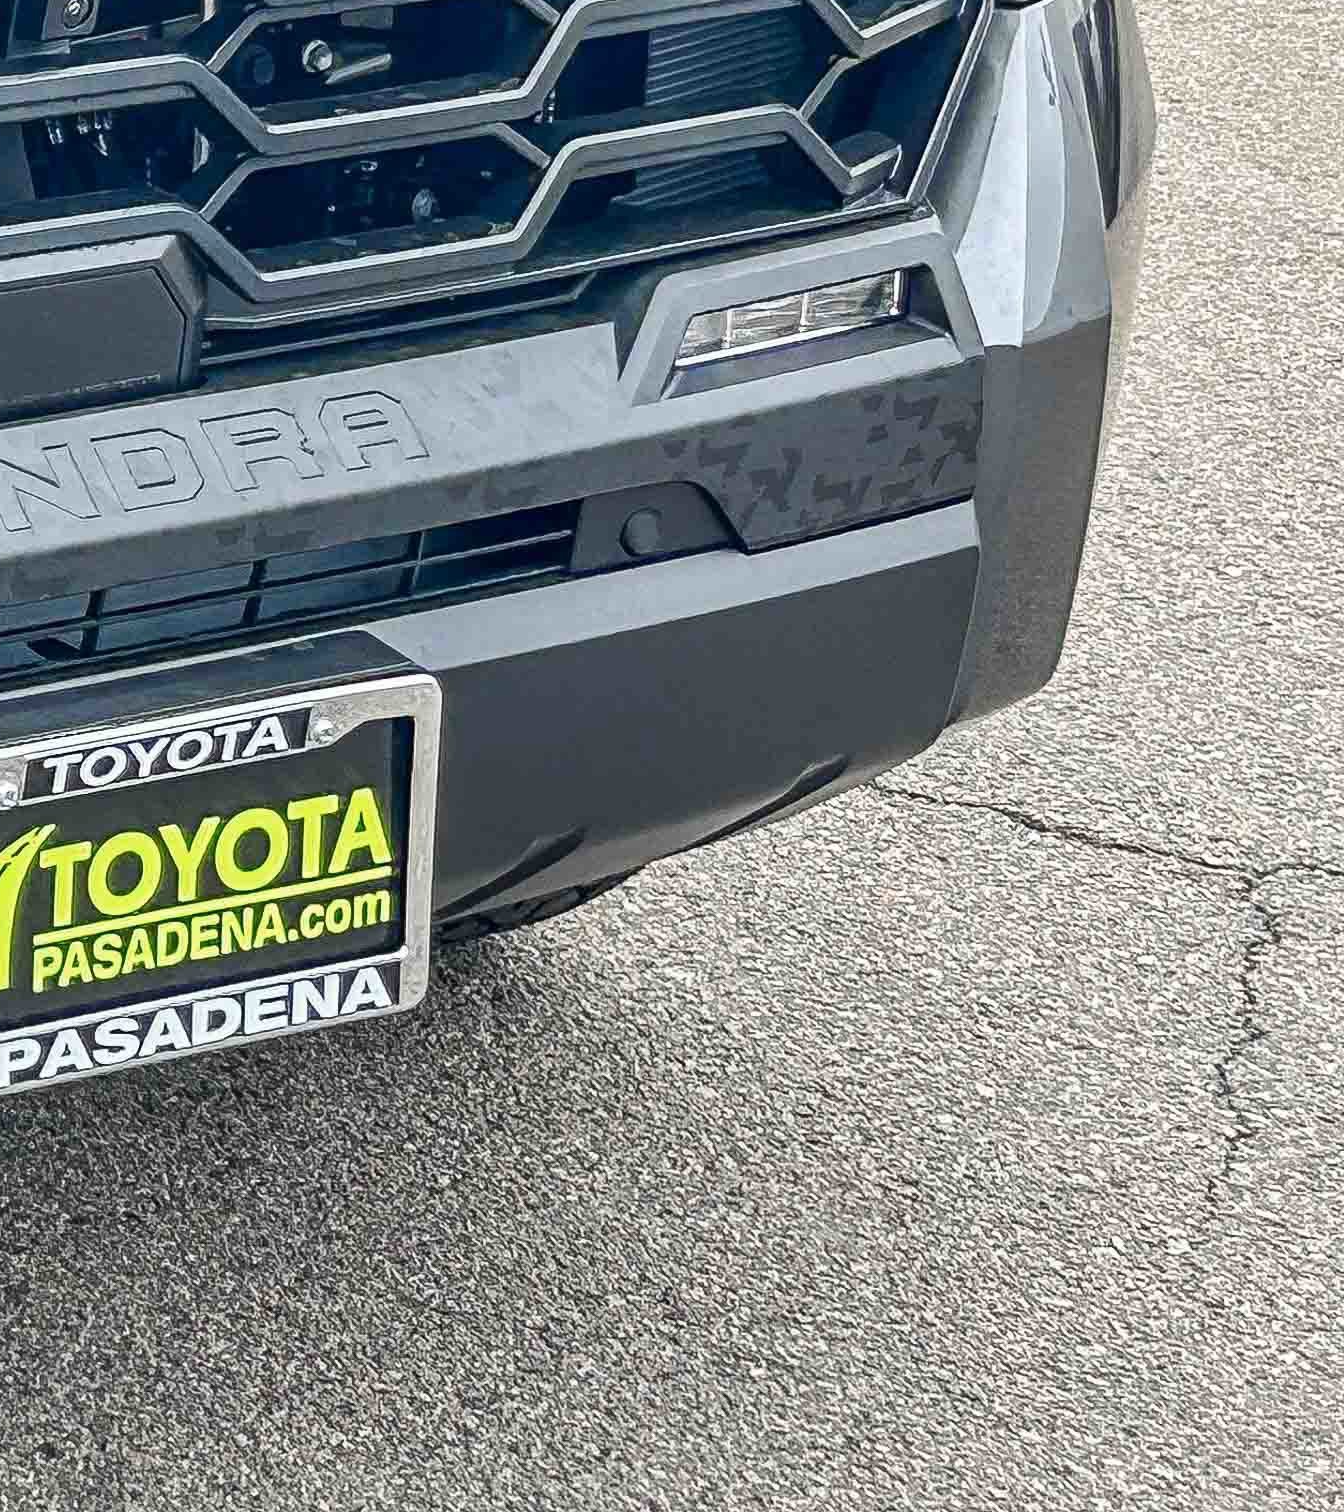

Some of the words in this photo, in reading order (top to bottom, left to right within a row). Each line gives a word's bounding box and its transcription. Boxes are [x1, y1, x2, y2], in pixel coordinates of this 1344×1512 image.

[44, 716, 290, 795] TOYOTA
[39, 787, 393, 927] TOYOTA
[32, 889, 391, 993] PASADENA.com
